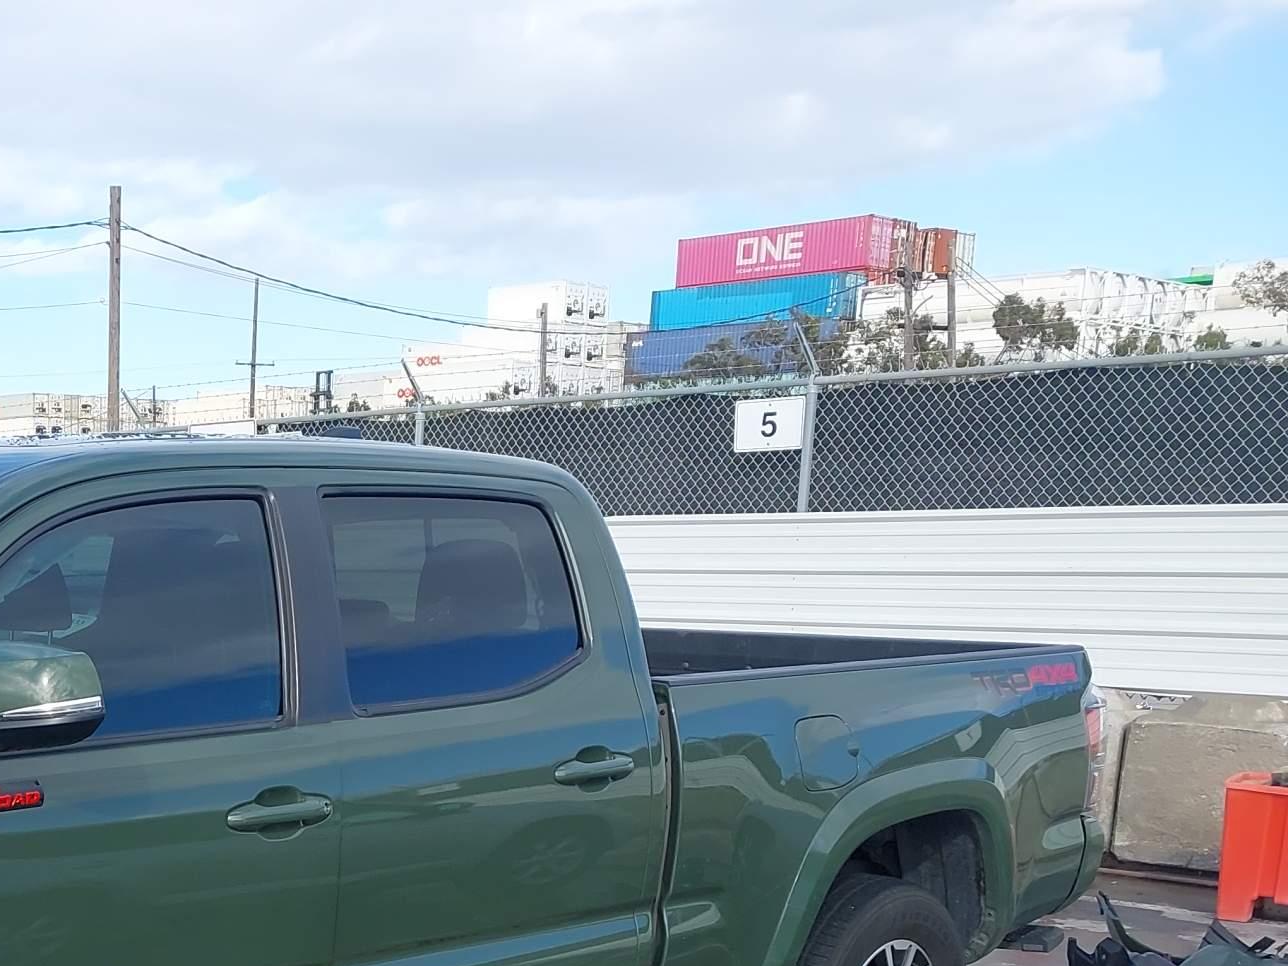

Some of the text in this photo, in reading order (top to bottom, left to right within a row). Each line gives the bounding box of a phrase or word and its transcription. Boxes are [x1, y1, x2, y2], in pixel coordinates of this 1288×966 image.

[736, 231, 804, 266] ONE
[416, 355, 443, 367] OOCL
[760, 411, 778, 438] 5
